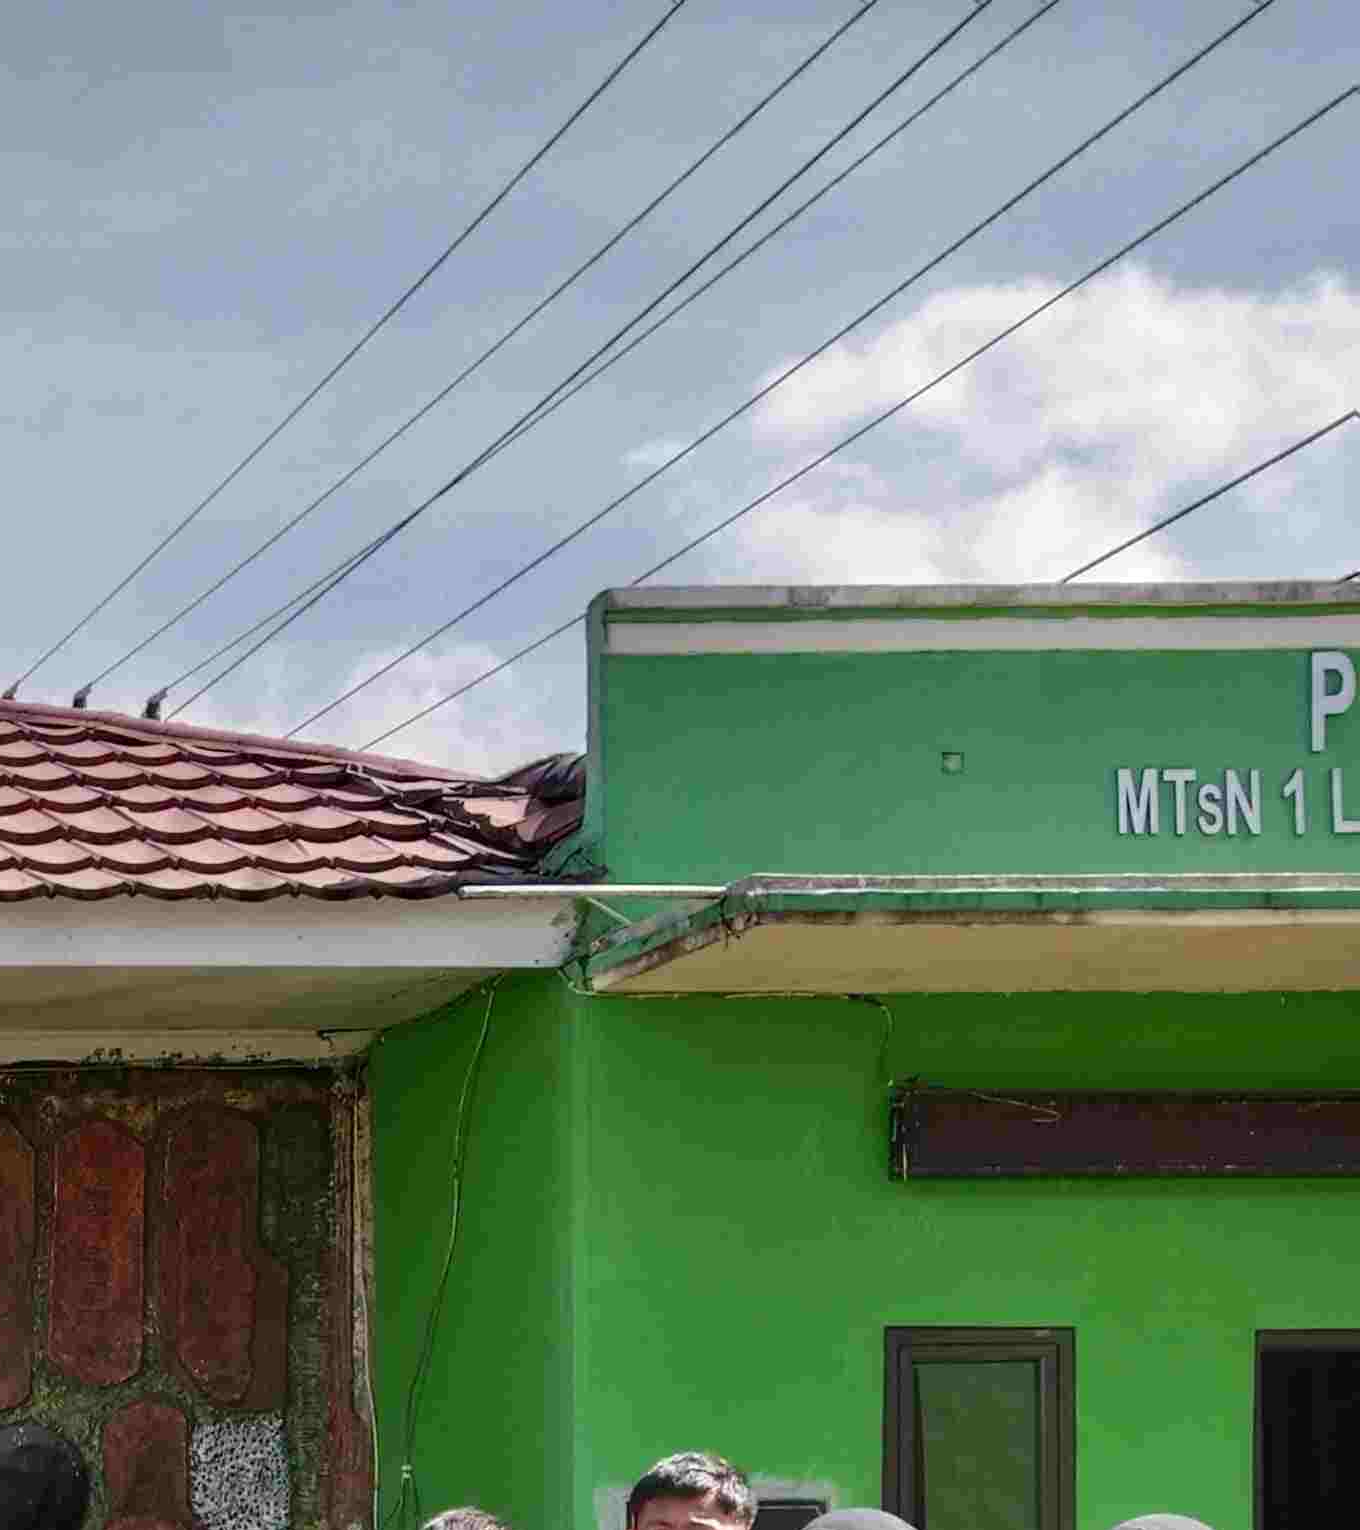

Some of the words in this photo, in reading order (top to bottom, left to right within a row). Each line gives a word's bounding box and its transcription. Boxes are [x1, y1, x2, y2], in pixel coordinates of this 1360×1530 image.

[1312, 651, 1356, 752] P
[1117, 768, 1263, 836] MTsN
[1282, 768, 1306, 836] 1
[1331, 768, 1360, 835] L
